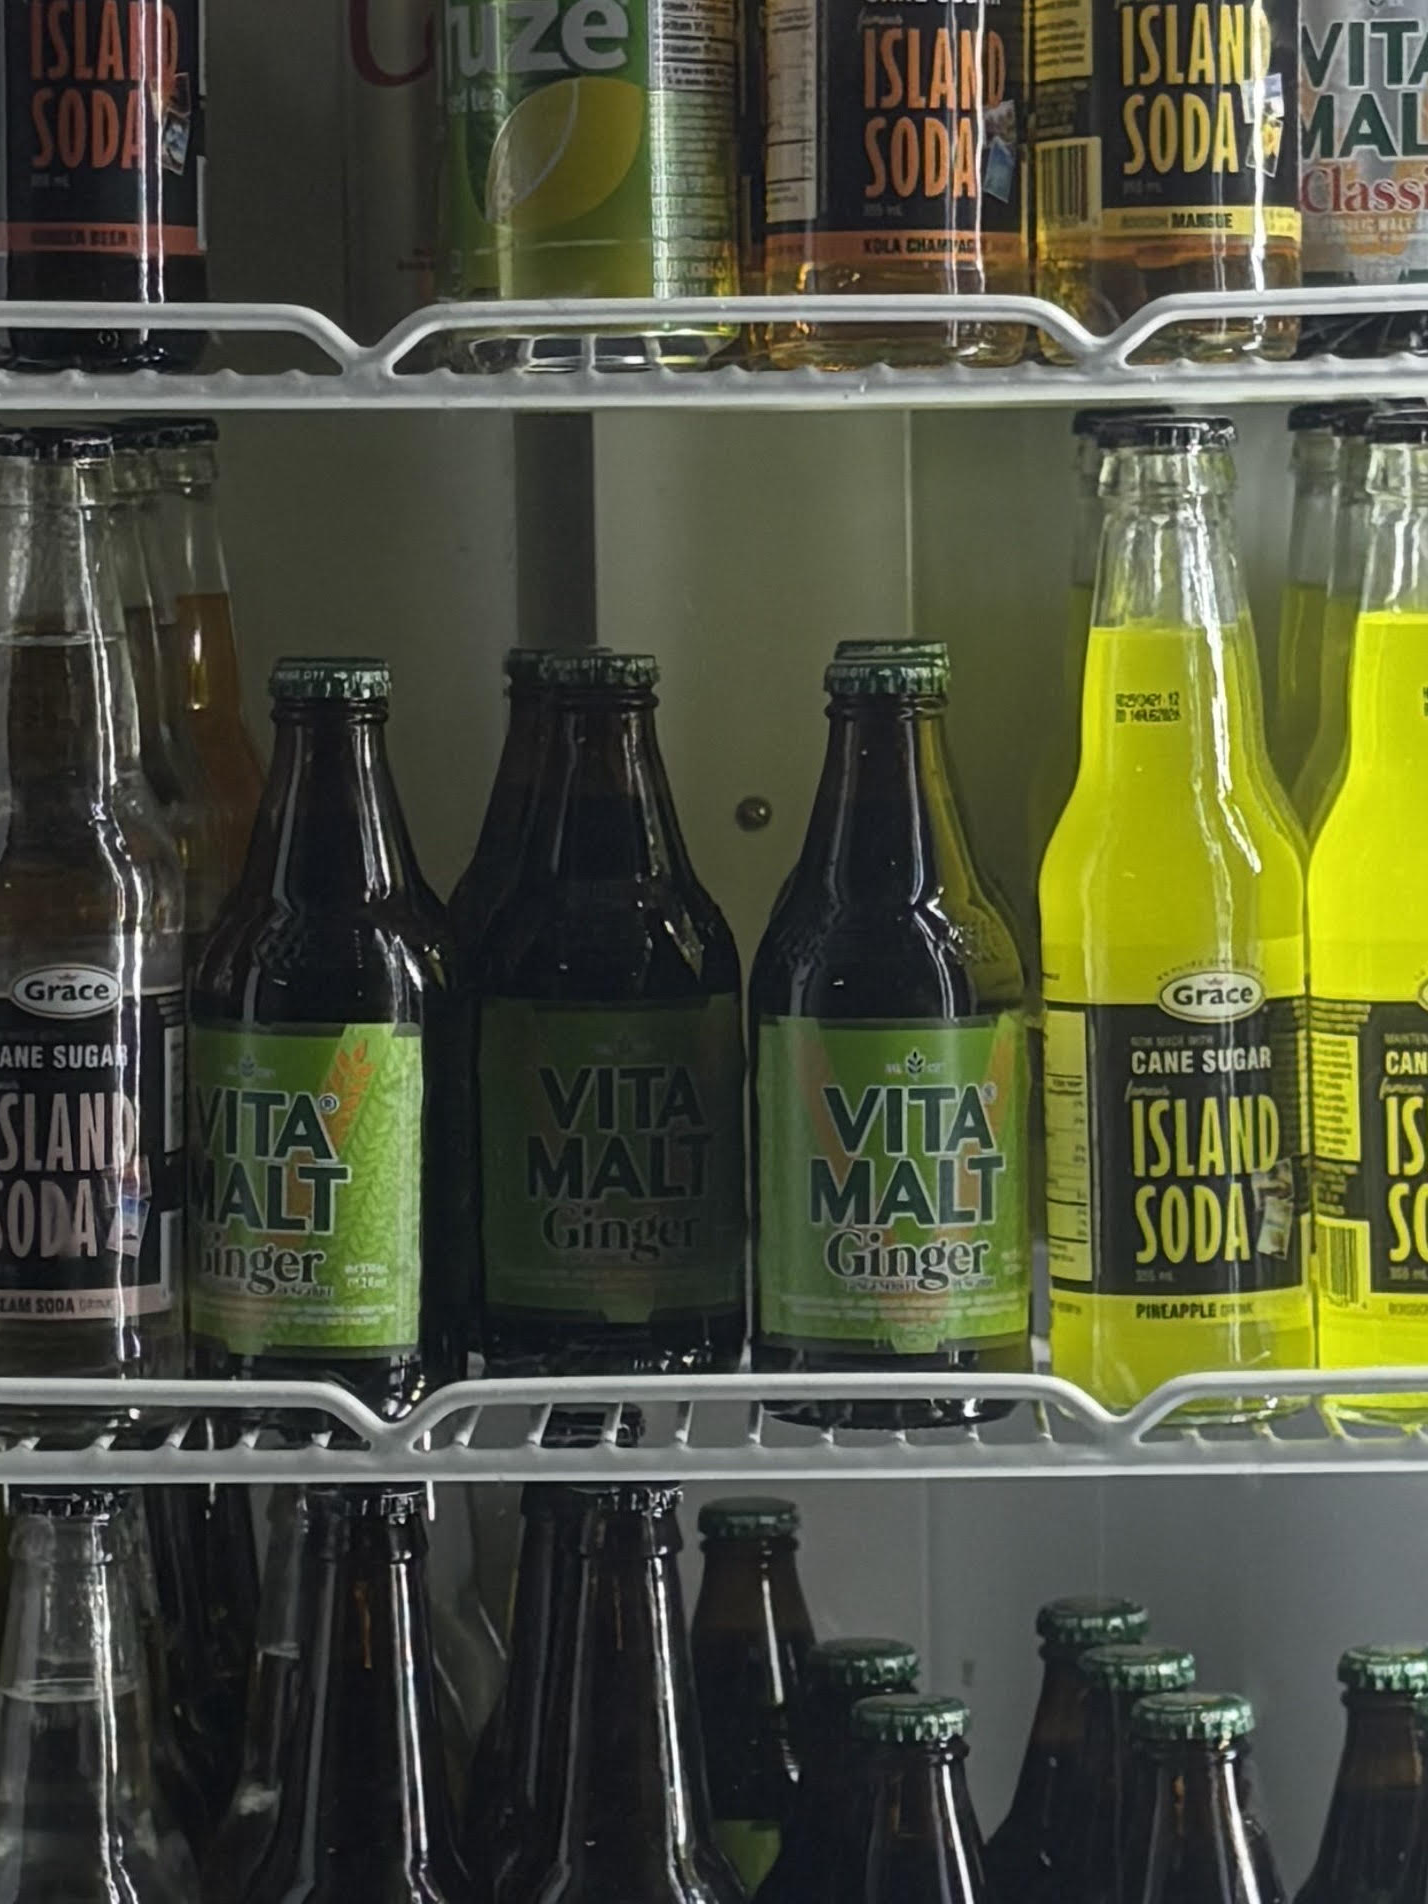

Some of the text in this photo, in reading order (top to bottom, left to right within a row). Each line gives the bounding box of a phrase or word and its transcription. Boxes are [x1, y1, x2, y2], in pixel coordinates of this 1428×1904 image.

[862, 27, 1007, 110] ISLAND
[1121, 2, 1272, 88] ISLAND
[30, 87, 148, 170] SODA
[864, 115, 977, 199] SODA
[1122, 92, 1240, 176] SODA
[24, 980, 111, 1002] Grace
[1172, 982, 1254, 1007] Grace
[51, 1044, 129, 1069] SUGAR
[1130, 1045, 1272, 1076] CANE SUGAR
[538, 1066, 705, 1131] VITA
[823, 1084, 995, 1153] VITA
[526, 1132, 712, 1198] MALT
[1130, 1094, 1281, 1179] ISLAND
[810, 1155, 1005, 1226] MALT
[1134, 1182, 1252, 1265] SODA
[542, 1205, 701, 1265] Ginger
[827, 1230, 990, 1290] Ginger
[1135, 1301, 1218, 1320] PINEAPPLE
